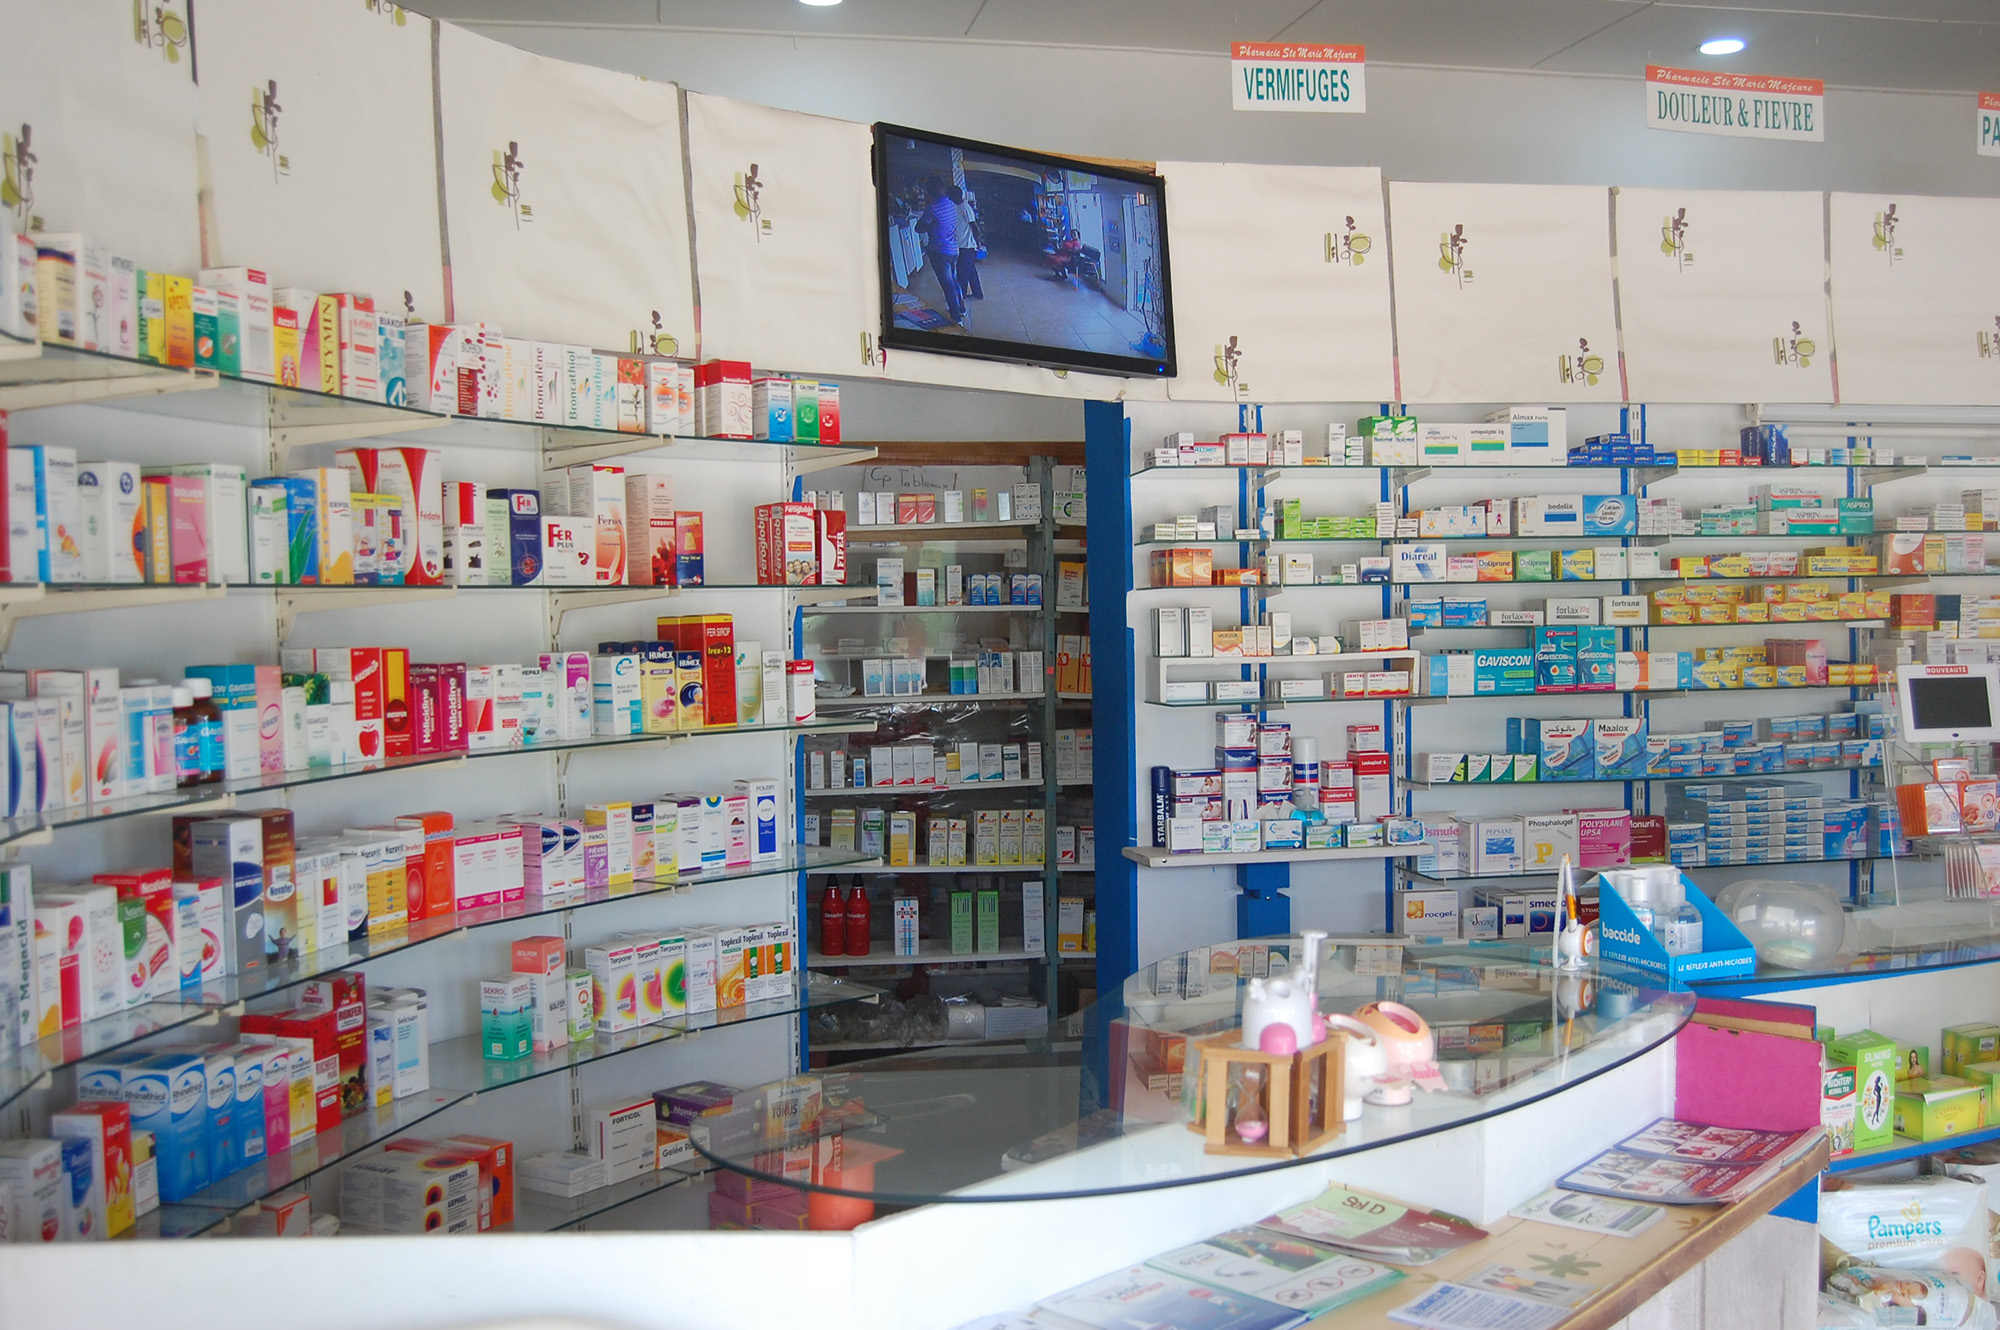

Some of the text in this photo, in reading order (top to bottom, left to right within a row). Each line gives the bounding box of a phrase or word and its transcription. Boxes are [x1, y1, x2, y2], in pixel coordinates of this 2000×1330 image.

[1240, 46, 1356, 61] Pharmacie Ste Marie Majeure
[1244, 68, 1349, 102] VERMIFUGES
[1657, 70, 1812, 92] Pharmacie Ste Marie Majeure
[1658, 90, 1813, 131] DOULEUR & FIEVRE
[535, 347, 544, 420] Broncalène
[568, 350, 577, 420] Broncathiol
[517, 496, 532, 511] FER
[420, 511, 441, 520] Fedate
[785, 505, 813, 515] Feroglobin
[597, 514, 623, 527] Ferox
[548, 523, 573, 548] FER
[157, 515, 167, 576] Dolko
[757, 509, 768, 578] Feroglobin
[1401, 551, 1438, 562] Diareal
[1562, 558, 1591, 566] Doliprane
[1478, 558, 1511, 568] Doliprane
[1520, 558, 1550, 567] Doliprane
[1556, 606, 1579, 614] forlax
[707, 627, 731, 637] FER SIROP
[649, 650, 673, 659] HUMEX
[708, 646, 732, 655] Irex-12
[679, 658, 700, 667] HUMEX
[1477, 654, 1532, 667] GAVISCON
[1926, 666, 1968, 674] NOUVEAUTÉ
[449, 677, 458, 741] Hélicidine
[422, 688, 430, 744] Hélicidine
[1598, 724, 1628, 732] Maalox
[1157, 793, 1165, 842] STARBALM
[1528, 819, 1574, 827] Phosphalugel
[1581, 819, 1623, 828] POLYSILANE
[1581, 828, 1601, 837] UPSA
[1424, 910, 1453, 918] rocgel
[743, 932, 763, 943] Toplexil
[767, 929, 789, 939] Toplexil
[1602, 921, 1641, 945] baccide
[721, 935, 742, 947] Toplexil
[660, 944, 683, 953] Terpone
[610, 954, 632, 964] Terpone
[637, 950, 659, 959] Terpone
[483, 987, 507, 995] SEKROL
[124, 1092, 168, 1100] Rhinathiol
[612, 1111, 641, 1125] FORTICOL
[448, 1170, 468, 1183] ARPHOS
[1868, 1215, 1942, 1239] Pampers
[1868, 1239, 1916, 1250] premium
